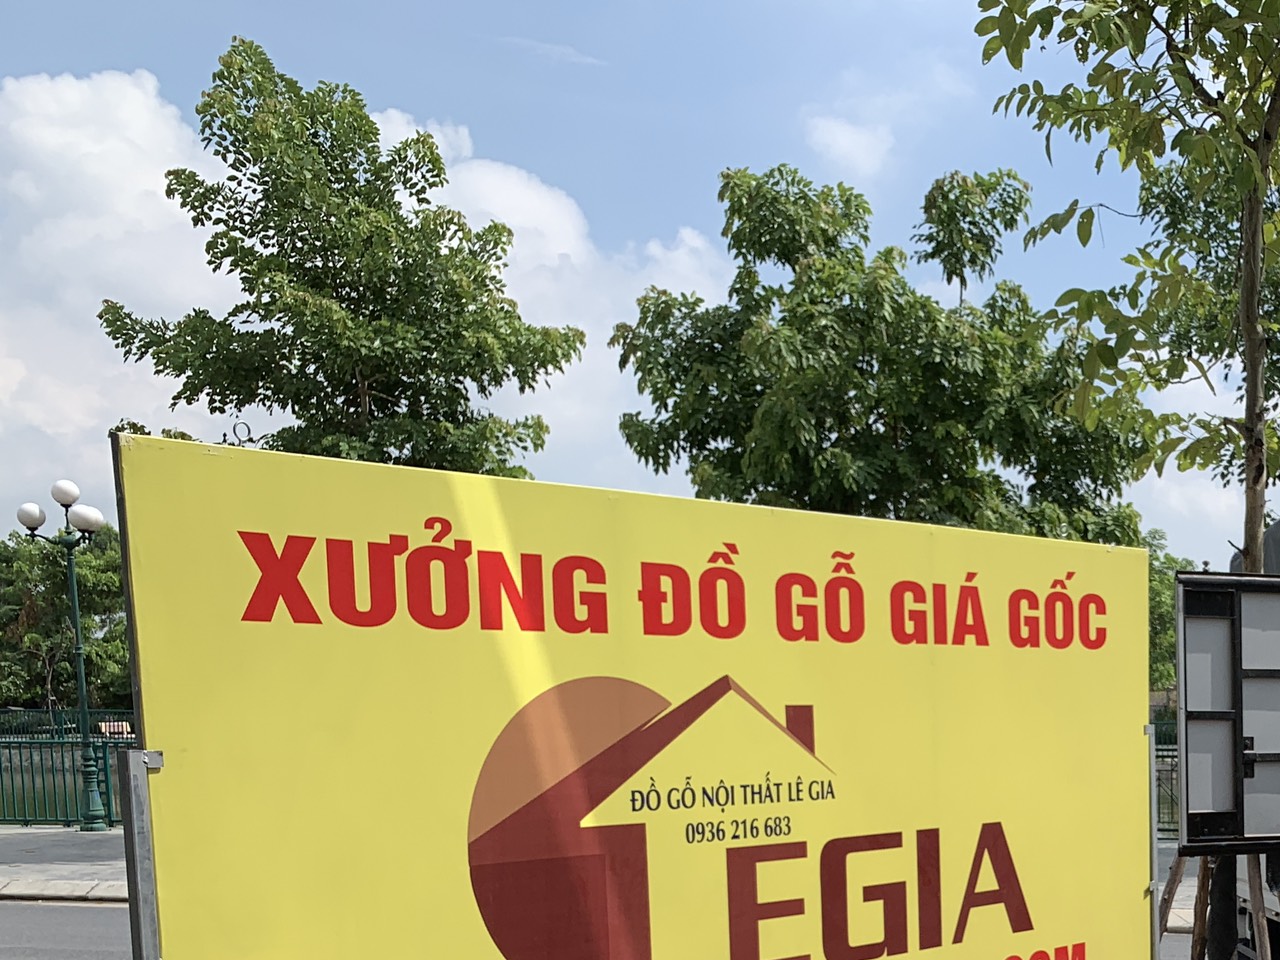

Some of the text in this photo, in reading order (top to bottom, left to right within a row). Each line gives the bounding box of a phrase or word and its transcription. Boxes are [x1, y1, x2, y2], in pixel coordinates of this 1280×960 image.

[236, 516, 1108, 651] XƯỞNG ĐỒ GỖ GIÁ GỐC
[630, 771, 836, 813] ĐỒ GỖ NỘI THẤT LÊ GIA
[685, 816, 792, 844] 0936 216 683
